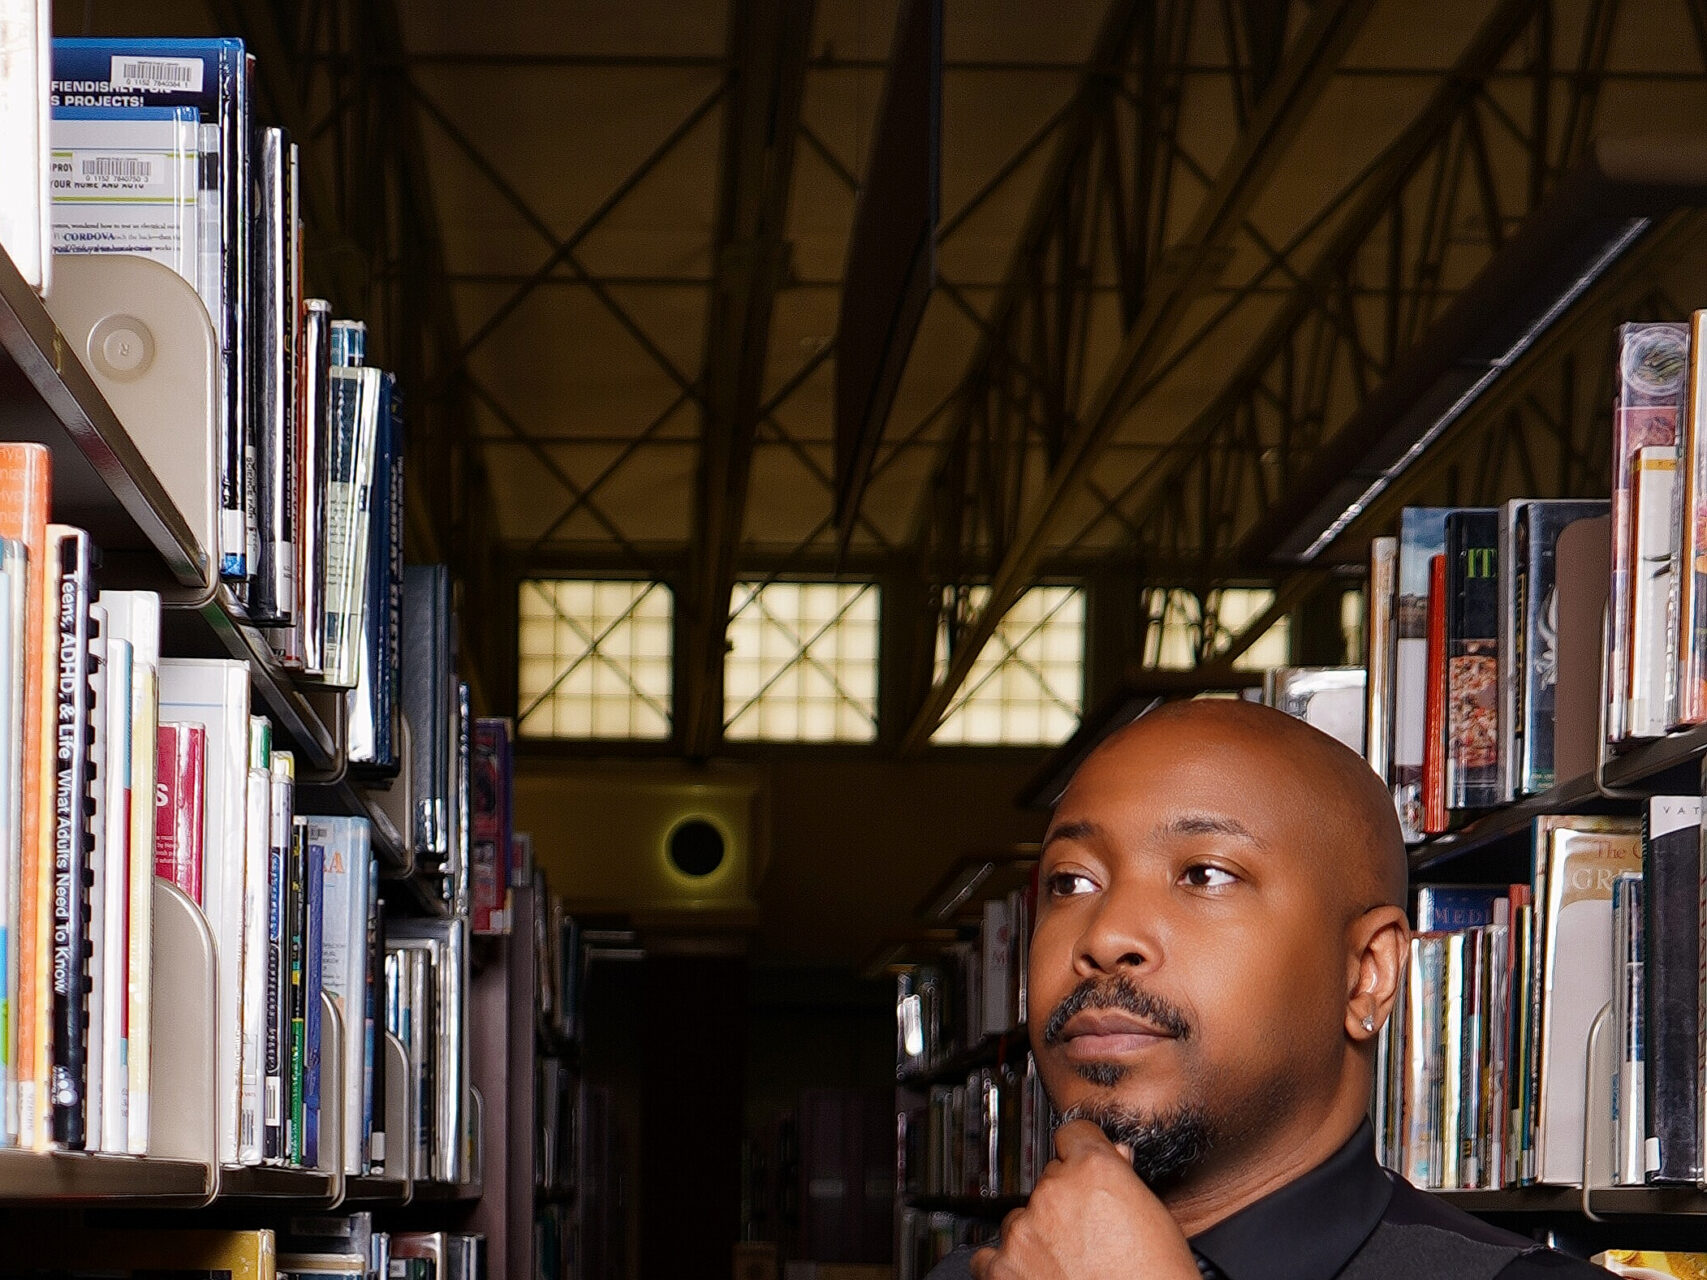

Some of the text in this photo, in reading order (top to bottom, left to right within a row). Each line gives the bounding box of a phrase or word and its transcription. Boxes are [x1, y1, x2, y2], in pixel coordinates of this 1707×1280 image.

[65, 96, 144, 107] PROJECTS!
[64, 232, 115, 241] CORDOVA
[247, 457, 257, 496] SCIENCE
[54, 570, 78, 994] Teens, ADHD, & Life What Adults Need To Know
[1594, 841, 1626, 859] The
